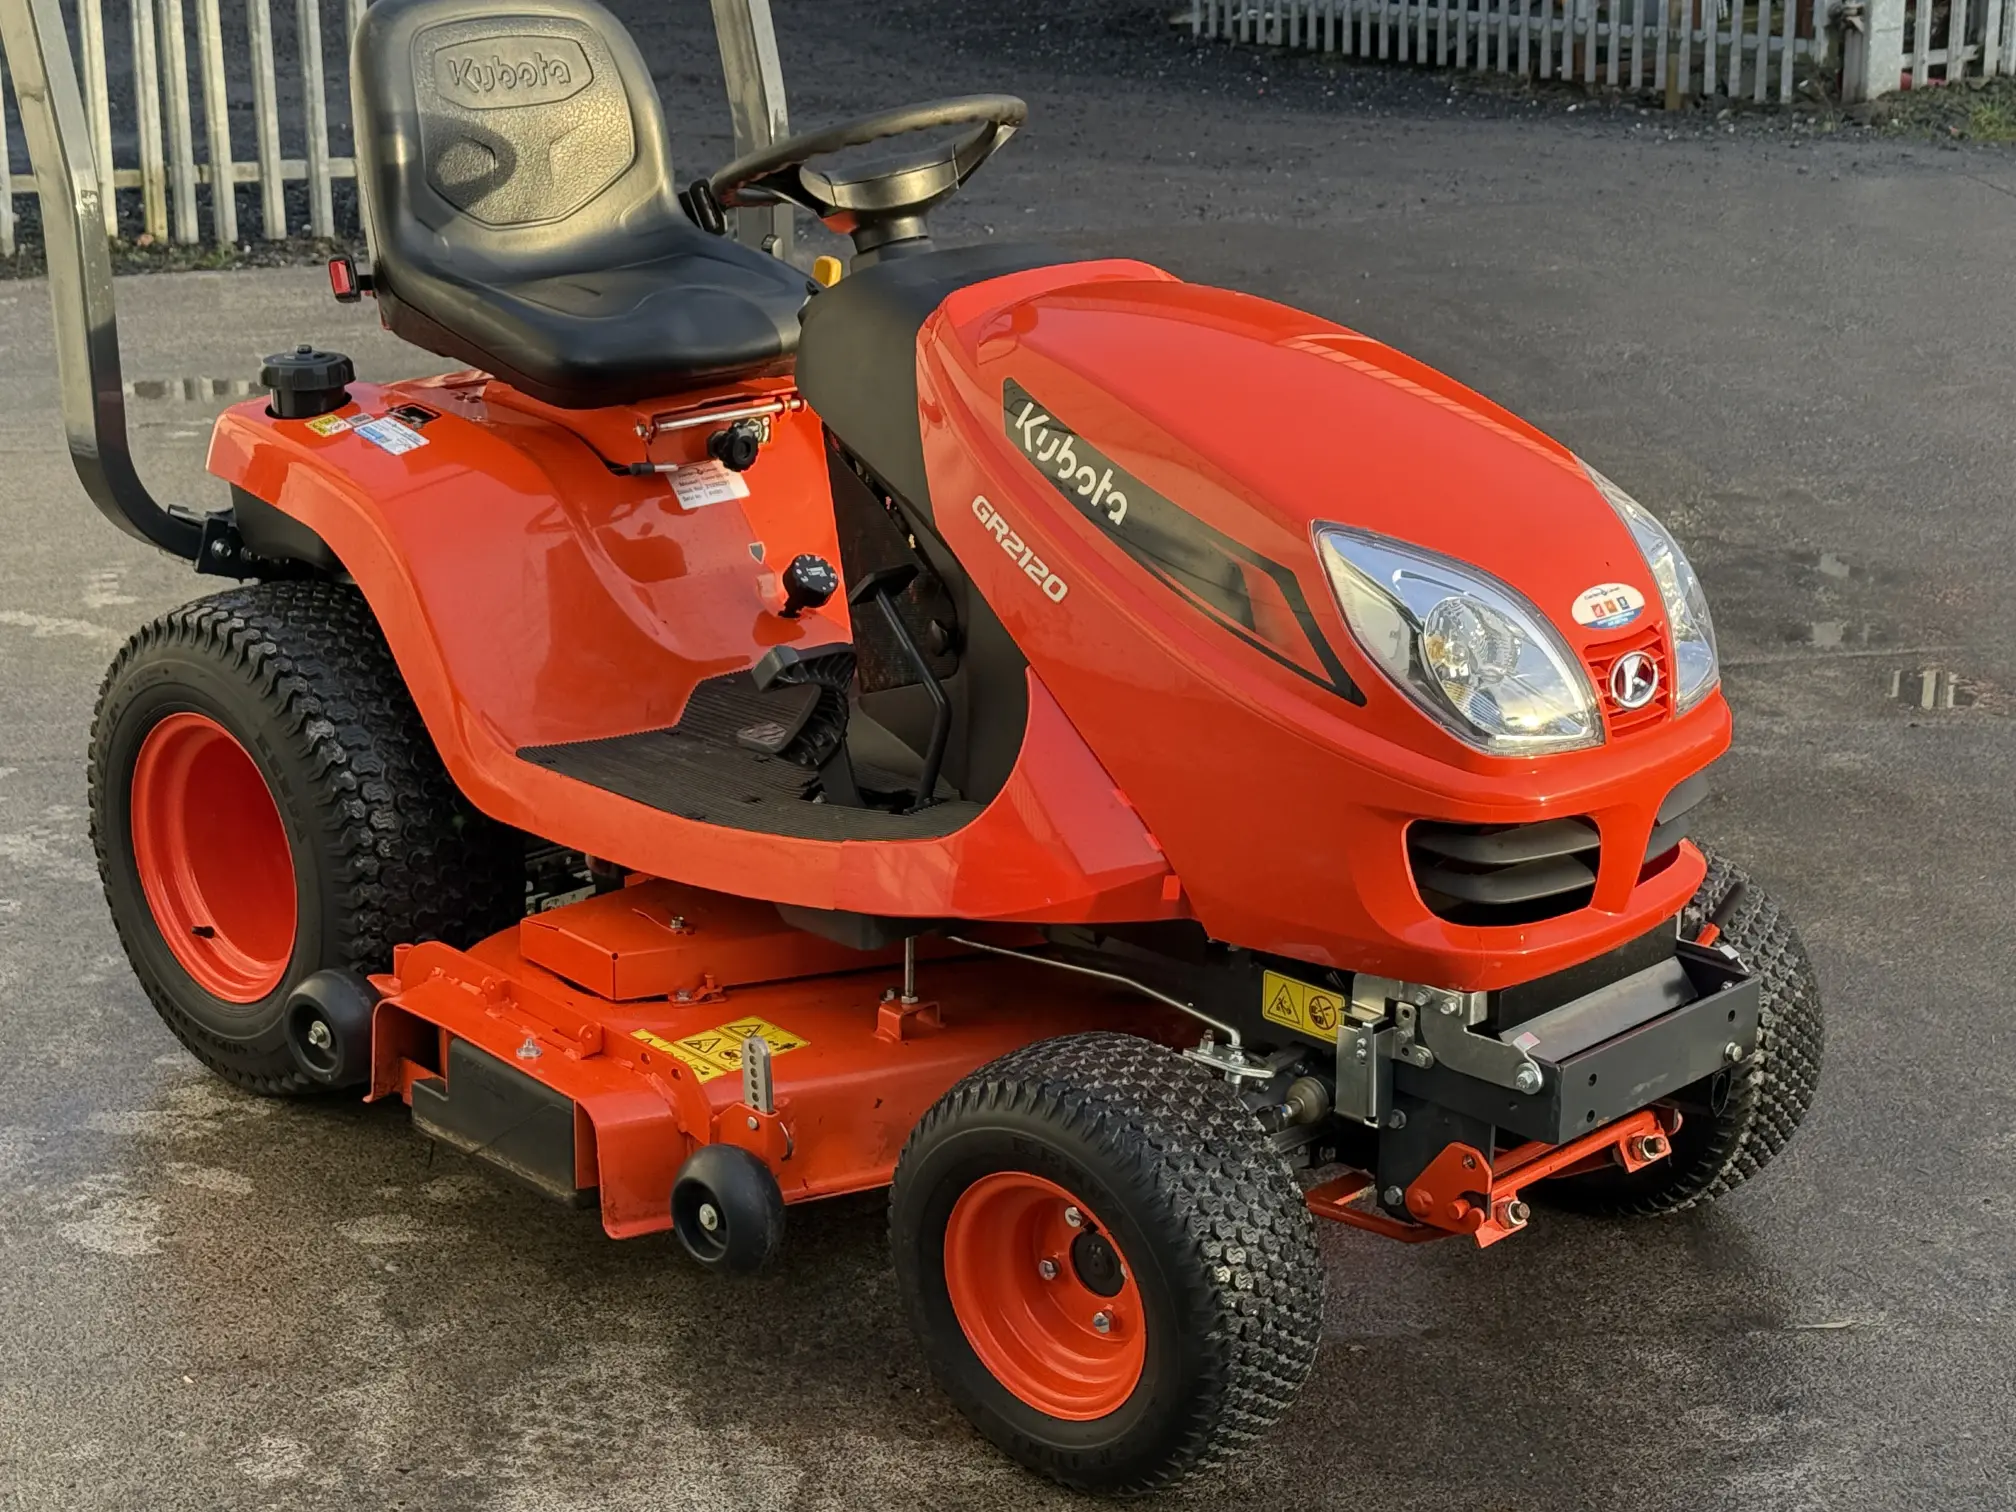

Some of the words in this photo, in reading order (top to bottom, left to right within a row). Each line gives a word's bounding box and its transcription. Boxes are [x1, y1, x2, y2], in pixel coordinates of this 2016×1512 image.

[450, 52, 571, 93] Kubota
[1015, 402, 1128, 525] Kubota
[972, 495, 1069, 603] GR2120
